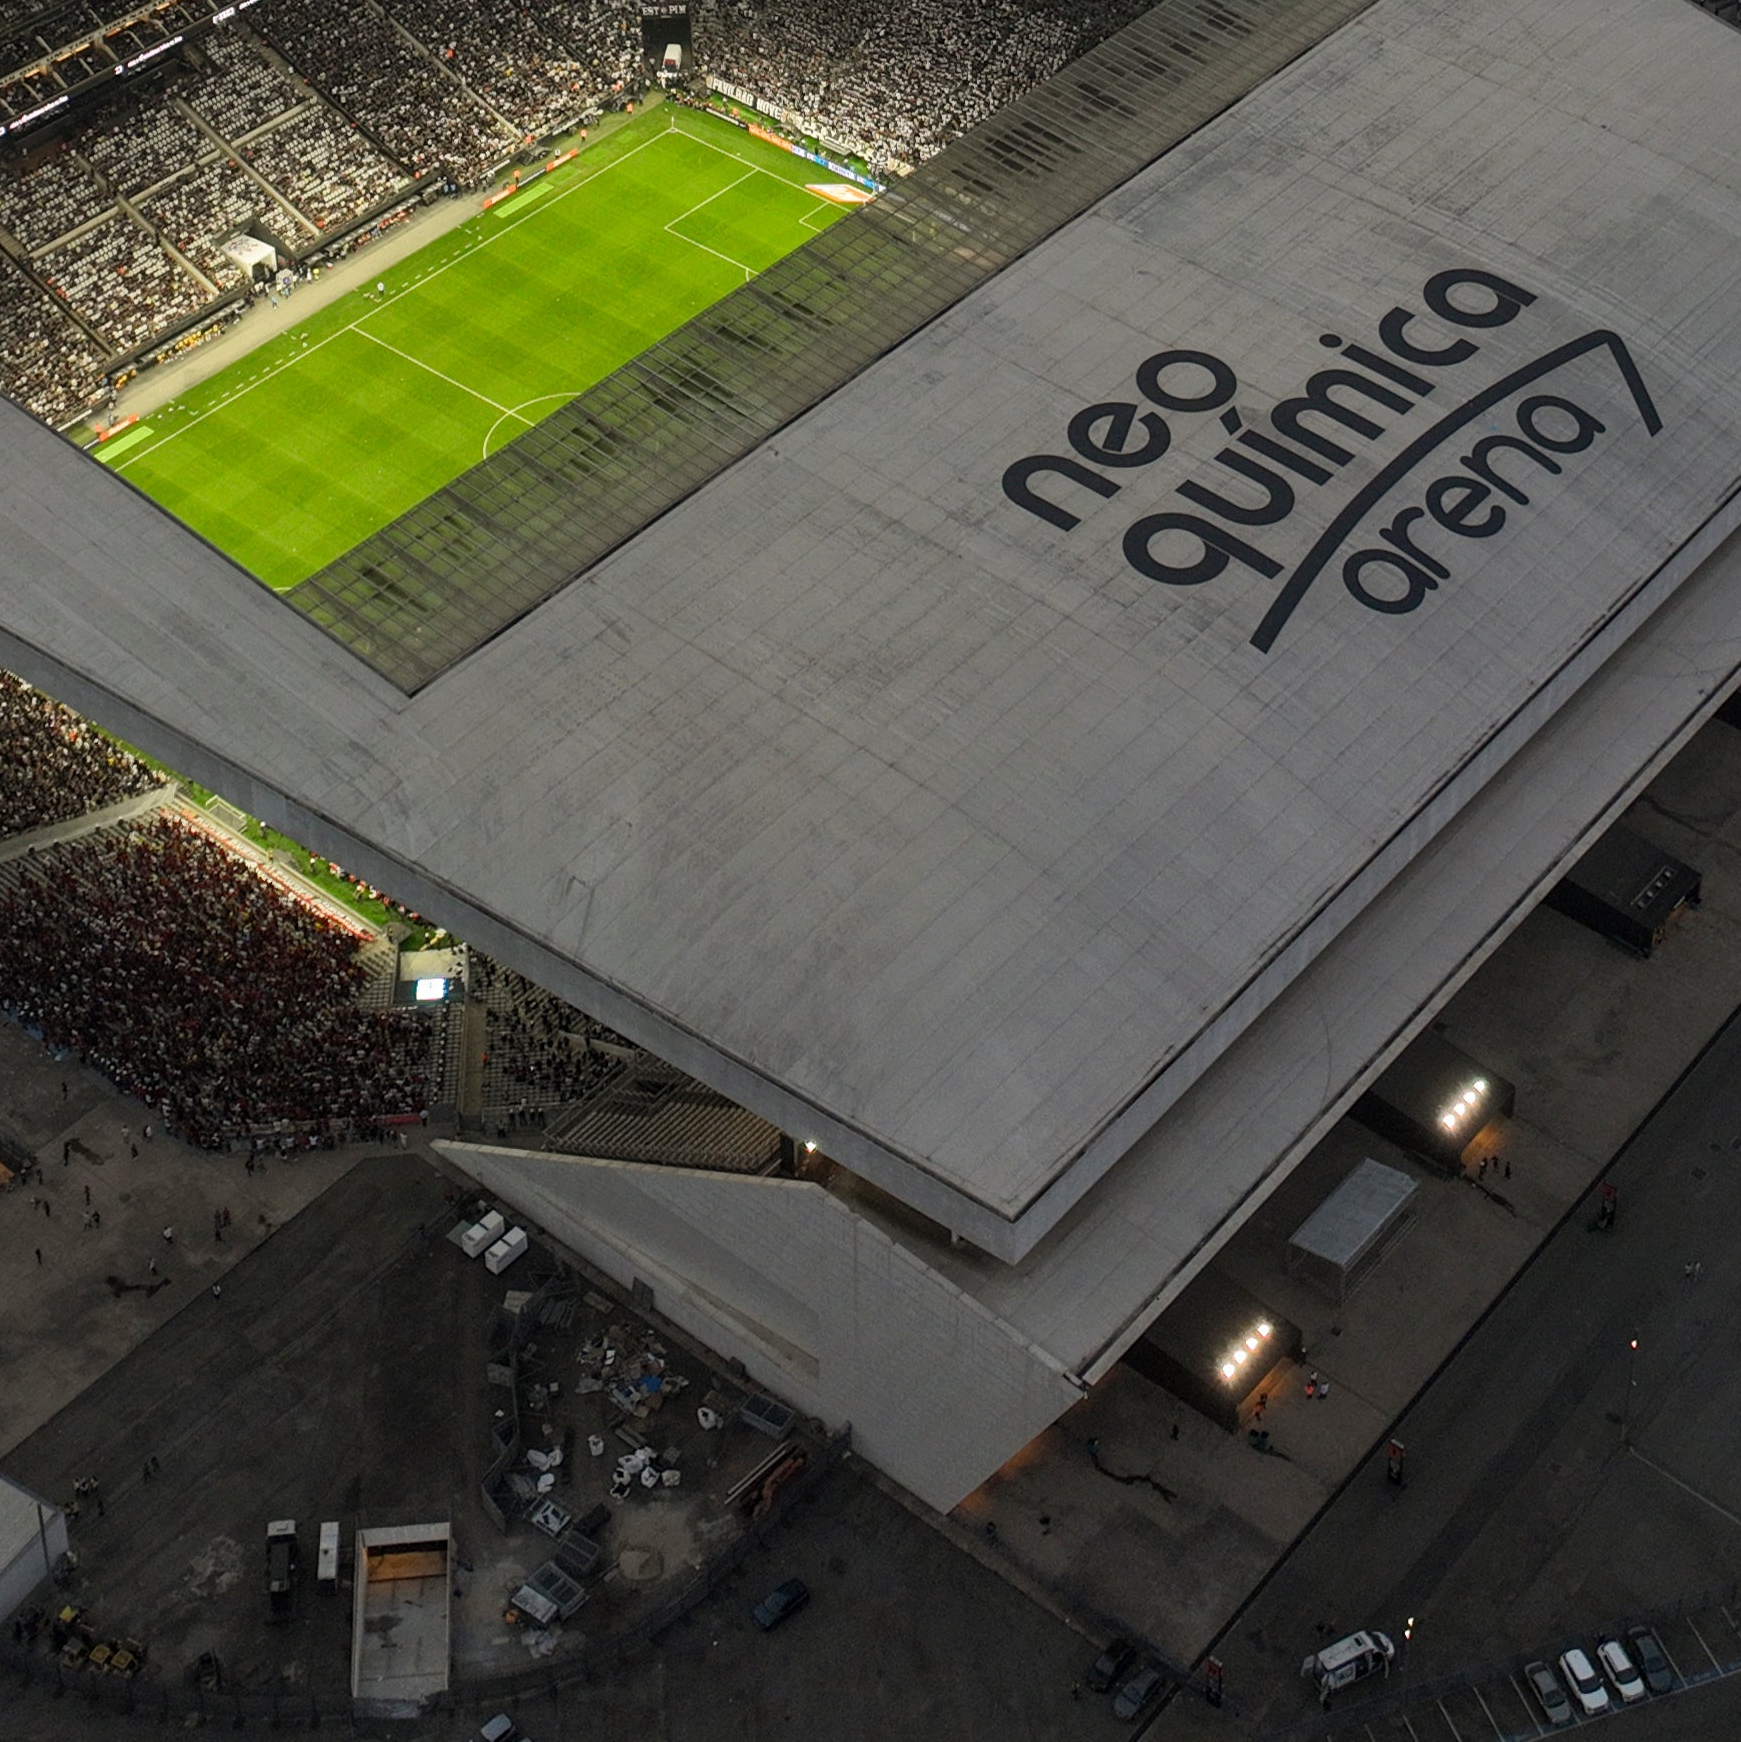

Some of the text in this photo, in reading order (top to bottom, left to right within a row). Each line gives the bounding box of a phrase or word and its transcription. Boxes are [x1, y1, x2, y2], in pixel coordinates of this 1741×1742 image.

[1001, 349, 1238, 532] neo
[1122, 268, 1539, 586] química
[1342, 395, 1607, 614] arena
